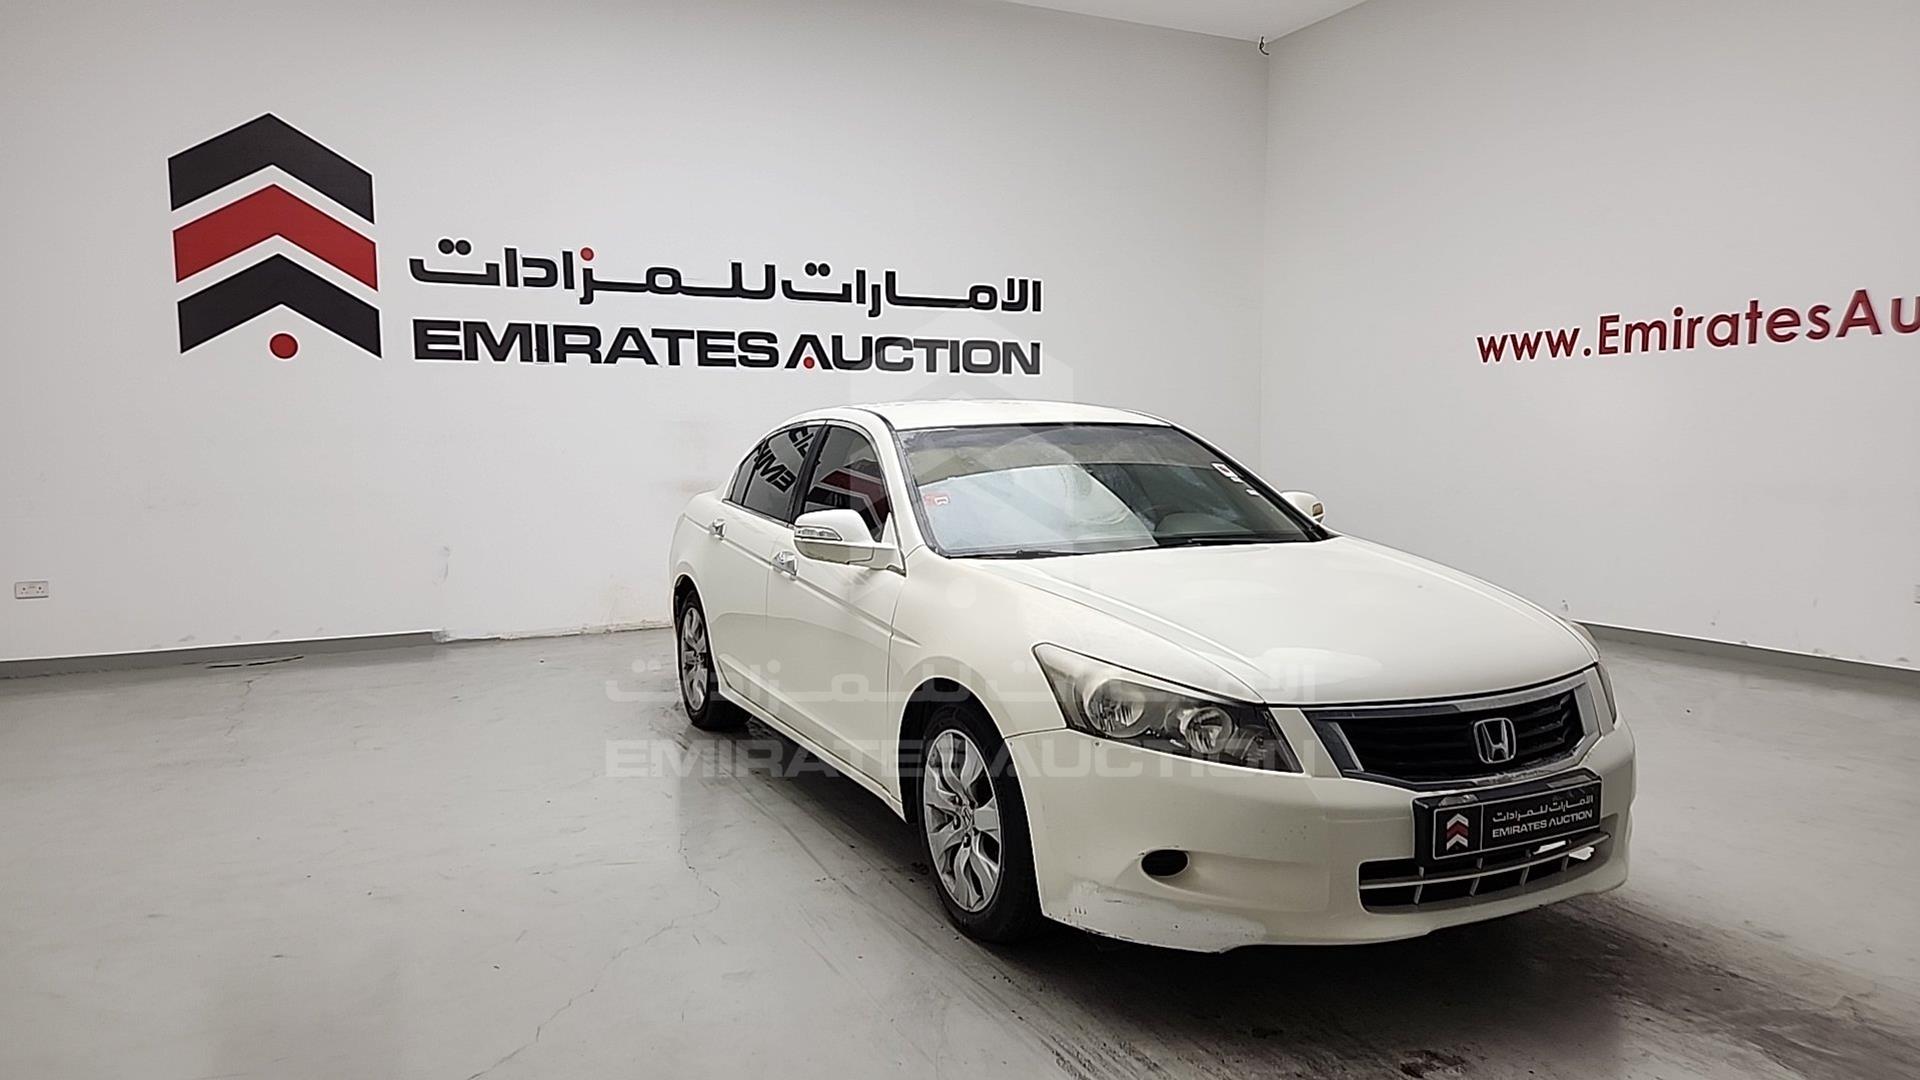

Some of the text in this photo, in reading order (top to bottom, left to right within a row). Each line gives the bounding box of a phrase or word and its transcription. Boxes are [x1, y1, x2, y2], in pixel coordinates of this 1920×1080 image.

[408, 238, 776, 305] للمزادات
[412, 318, 1041, 375] EMIRATES AUCTION
[1476, 288, 1920, 363] www.EmiratesAu
[1492, 808, 1594, 839] EMIRATES AUCTION
